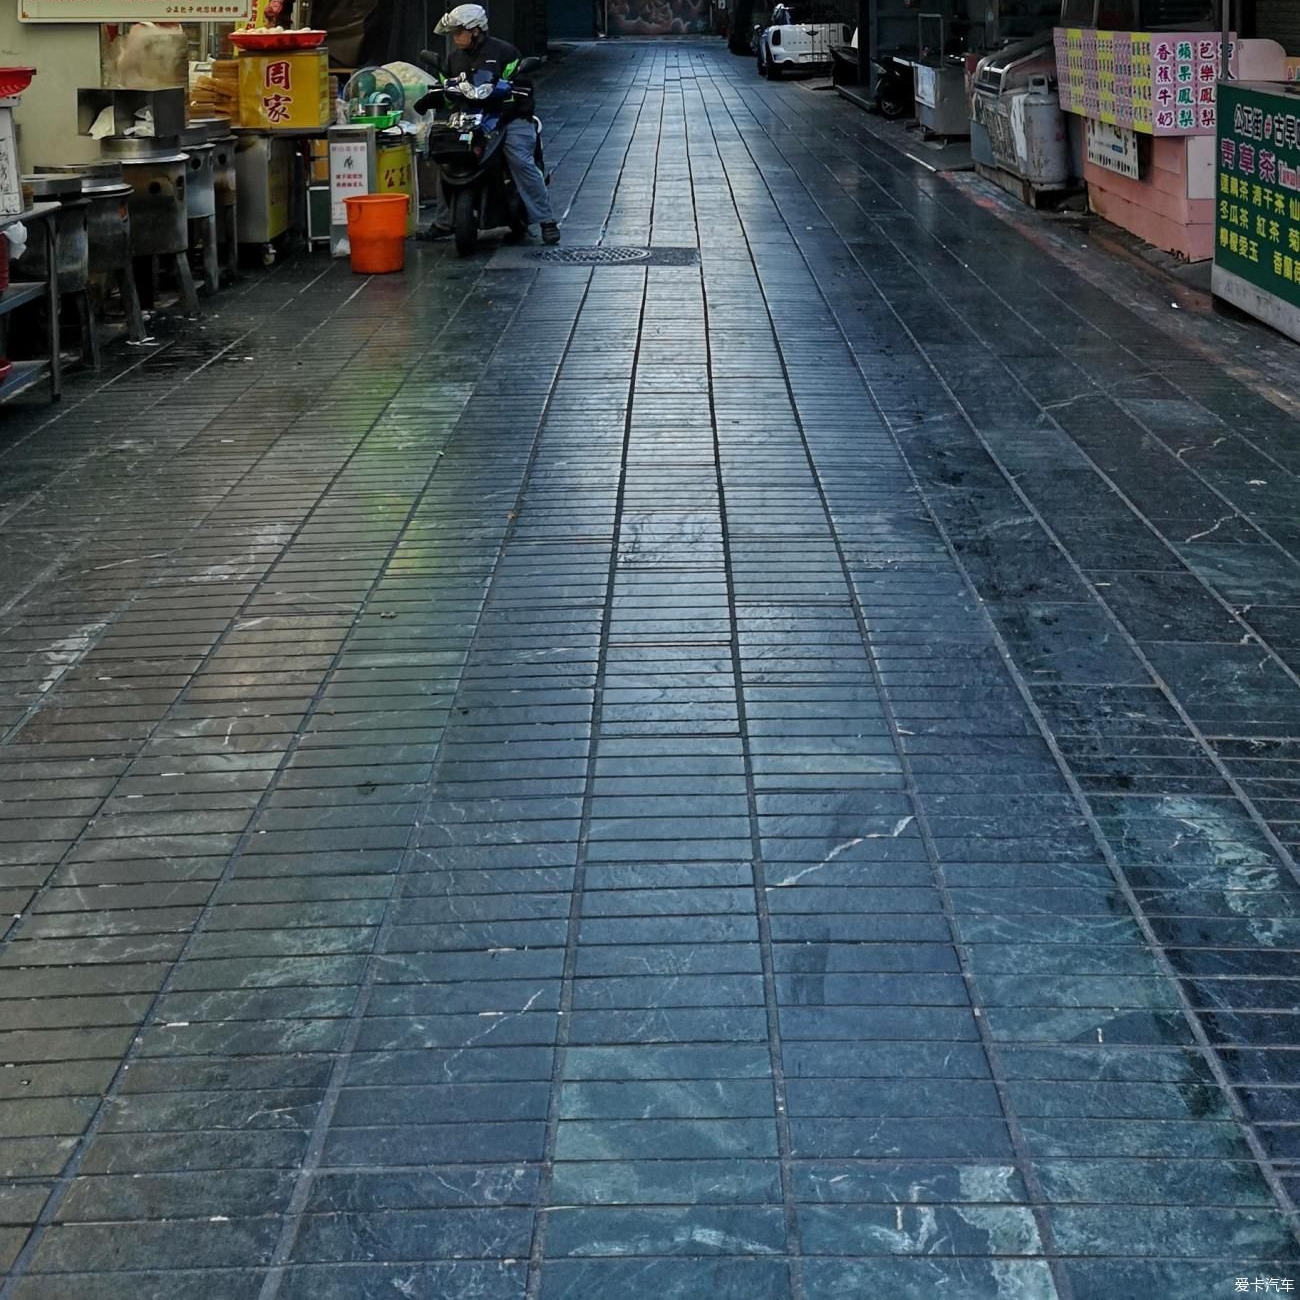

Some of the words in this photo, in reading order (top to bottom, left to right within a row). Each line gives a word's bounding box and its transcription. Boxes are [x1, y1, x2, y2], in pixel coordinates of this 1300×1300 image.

[263, 61, 292, 123] 周家
[1156, 43, 1173, 128] 香蕉牛奶
[1177, 42, 1194, 128] 蘋果鳳梨
[1199, 42, 1216, 127] 芭樂鳳梨
[1221, 138, 1275, 184] 青草茶
[1220, 200, 1249, 230] 冬瓜茶
[1256, 214, 1280, 244] 紅茶
